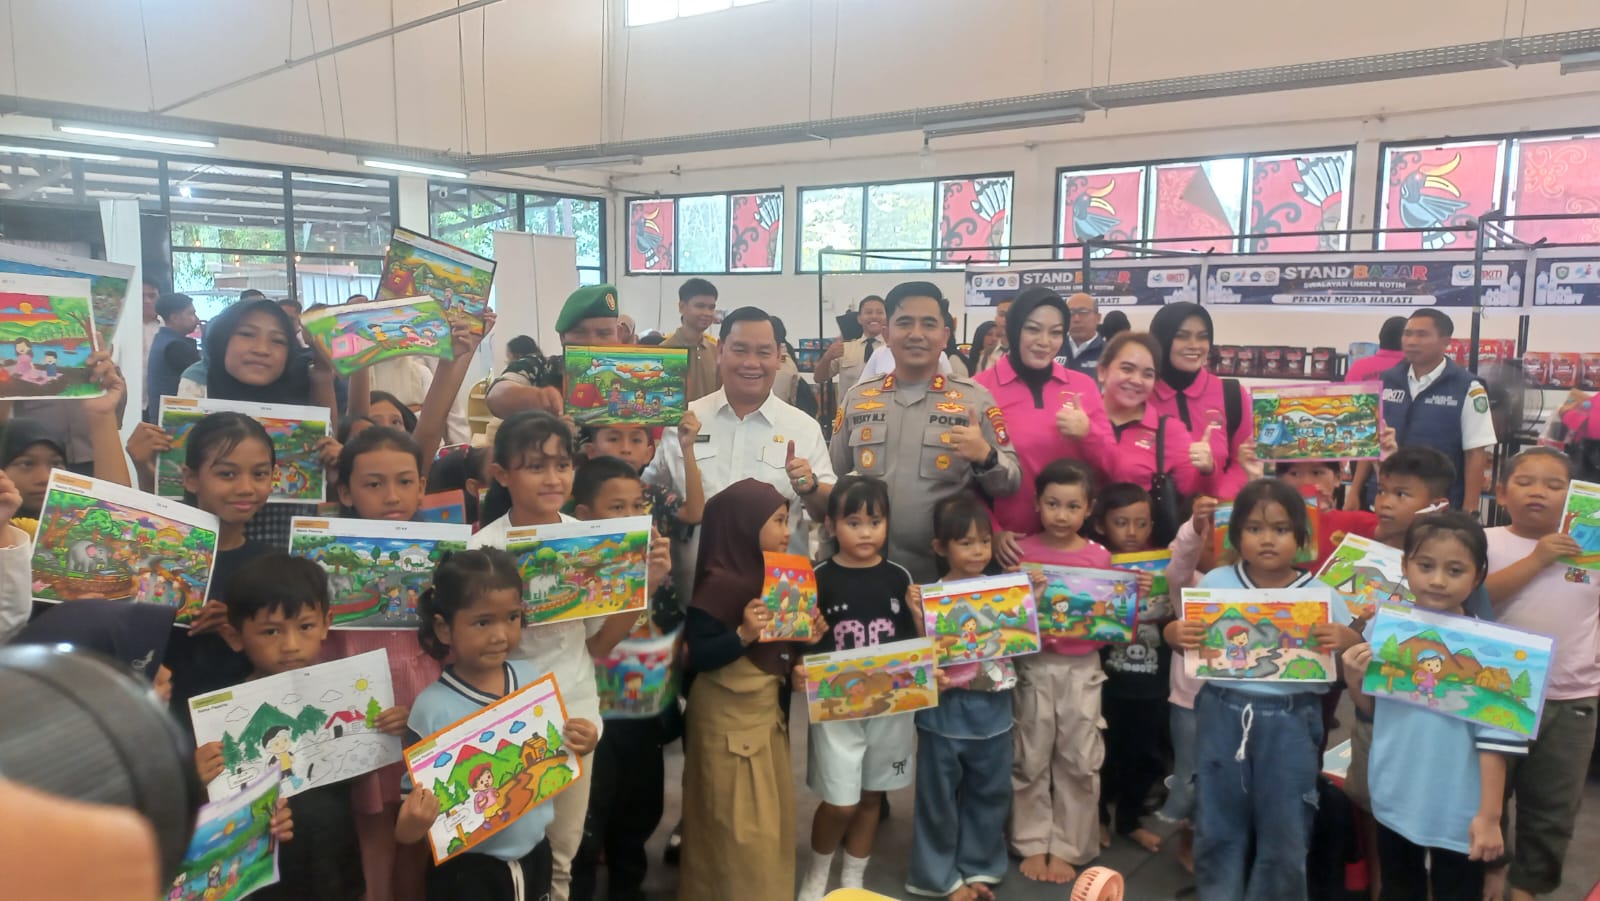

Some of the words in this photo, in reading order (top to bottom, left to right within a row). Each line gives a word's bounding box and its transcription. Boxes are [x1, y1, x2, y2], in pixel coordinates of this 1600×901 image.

[1023, 272, 1073, 284] STAND
[1283, 265, 1351, 280] STAND
[1352, 264, 1429, 280] BAZAR
[1292, 296, 1331, 304] PETANI
[1334, 296, 1367, 304] MUDA
[1369, 296, 1414, 304] HARATI
